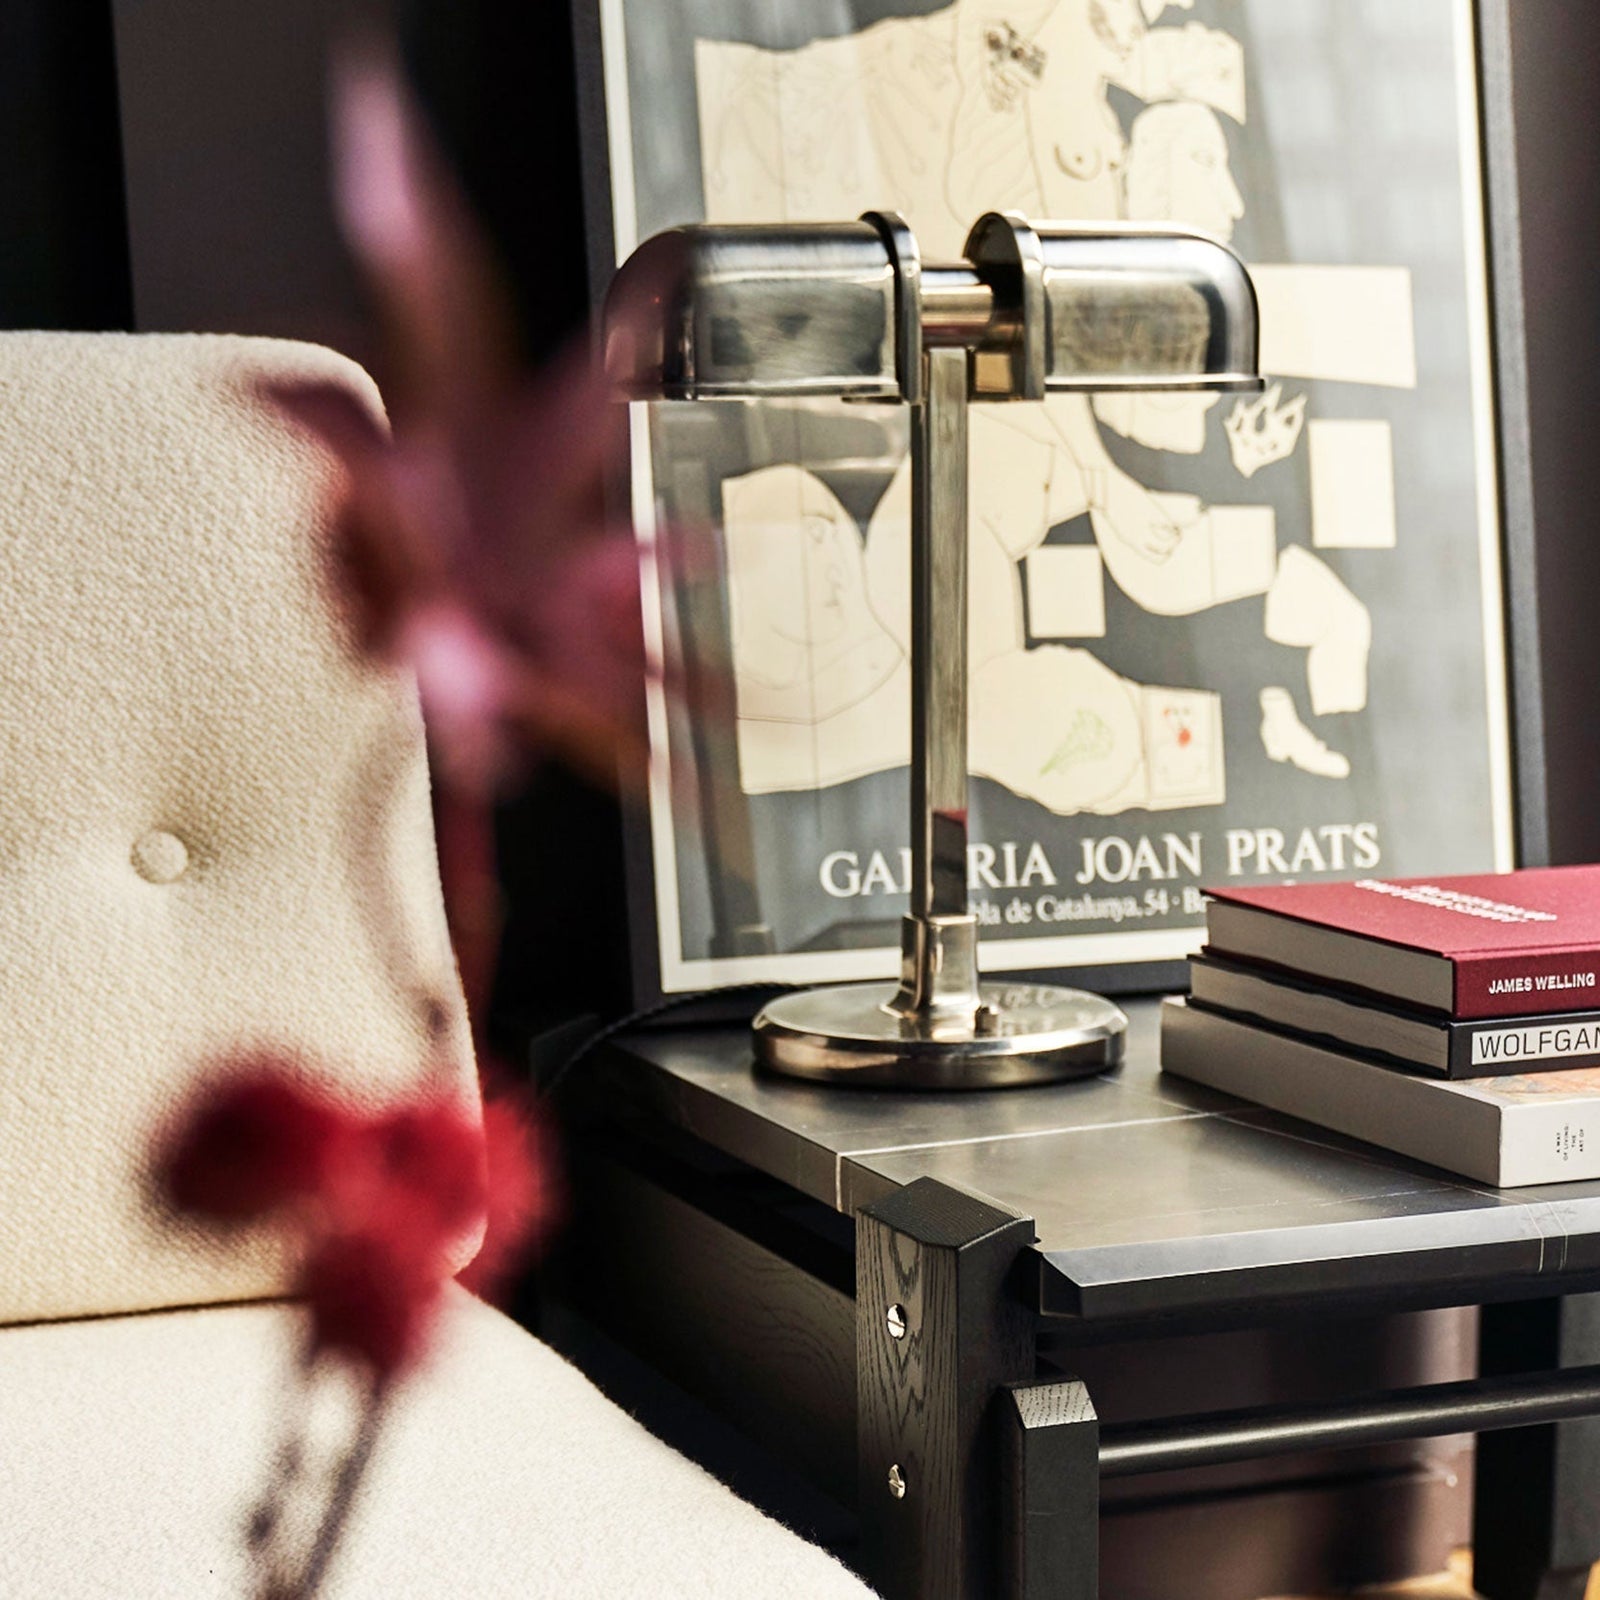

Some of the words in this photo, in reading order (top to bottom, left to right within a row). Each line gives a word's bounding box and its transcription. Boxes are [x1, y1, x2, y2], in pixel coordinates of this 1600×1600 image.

[819, 841, 1057, 898] GARIA
[1075, 832, 1202, 884] JOAN
[1226, 822, 1381, 875] PRATS
[1005, 897, 1033, 923] de
[1488, 977, 1533, 994] JAMES
[1535, 972, 1596, 990] WELLING
